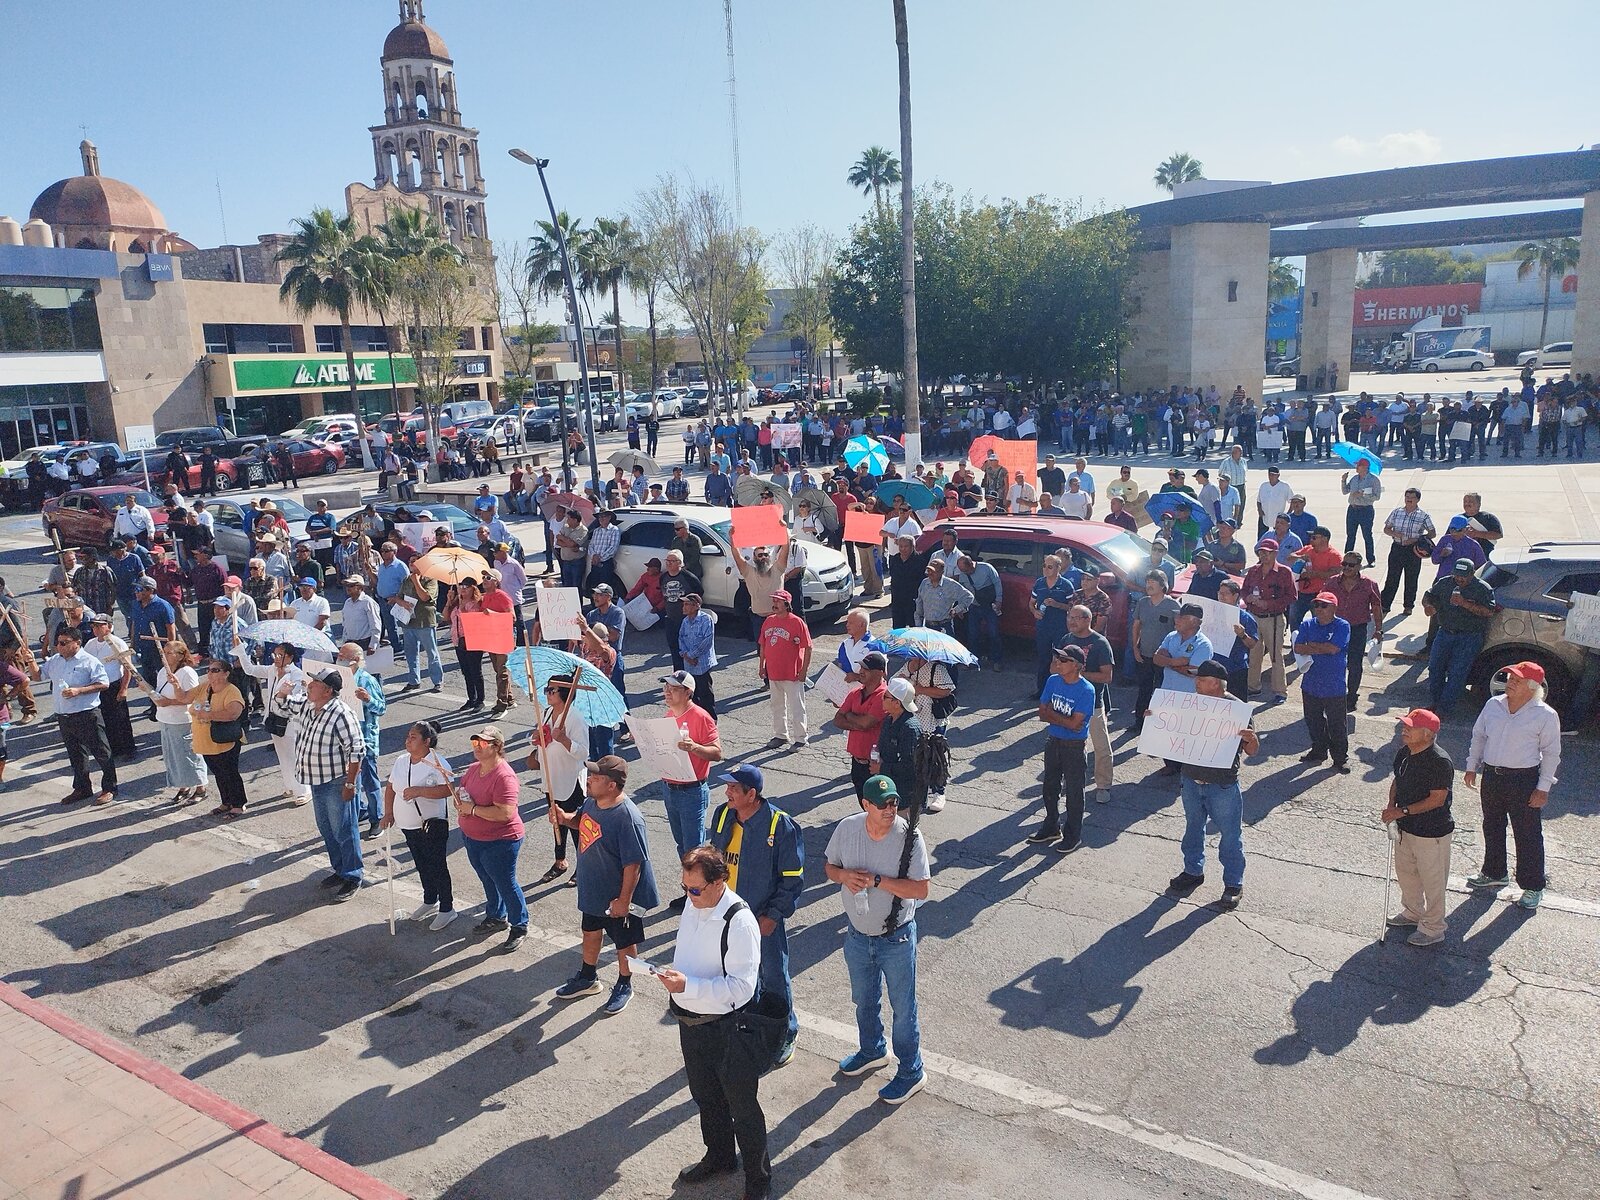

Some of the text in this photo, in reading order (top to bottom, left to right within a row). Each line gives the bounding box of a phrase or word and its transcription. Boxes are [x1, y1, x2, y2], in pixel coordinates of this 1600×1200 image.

[150, 263, 171, 272] BBVA
[1377, 304, 1469, 321] HERMANOS
[317, 362, 377, 383] AFIRME
[1160, 692, 1232, 717] YA BASTA
